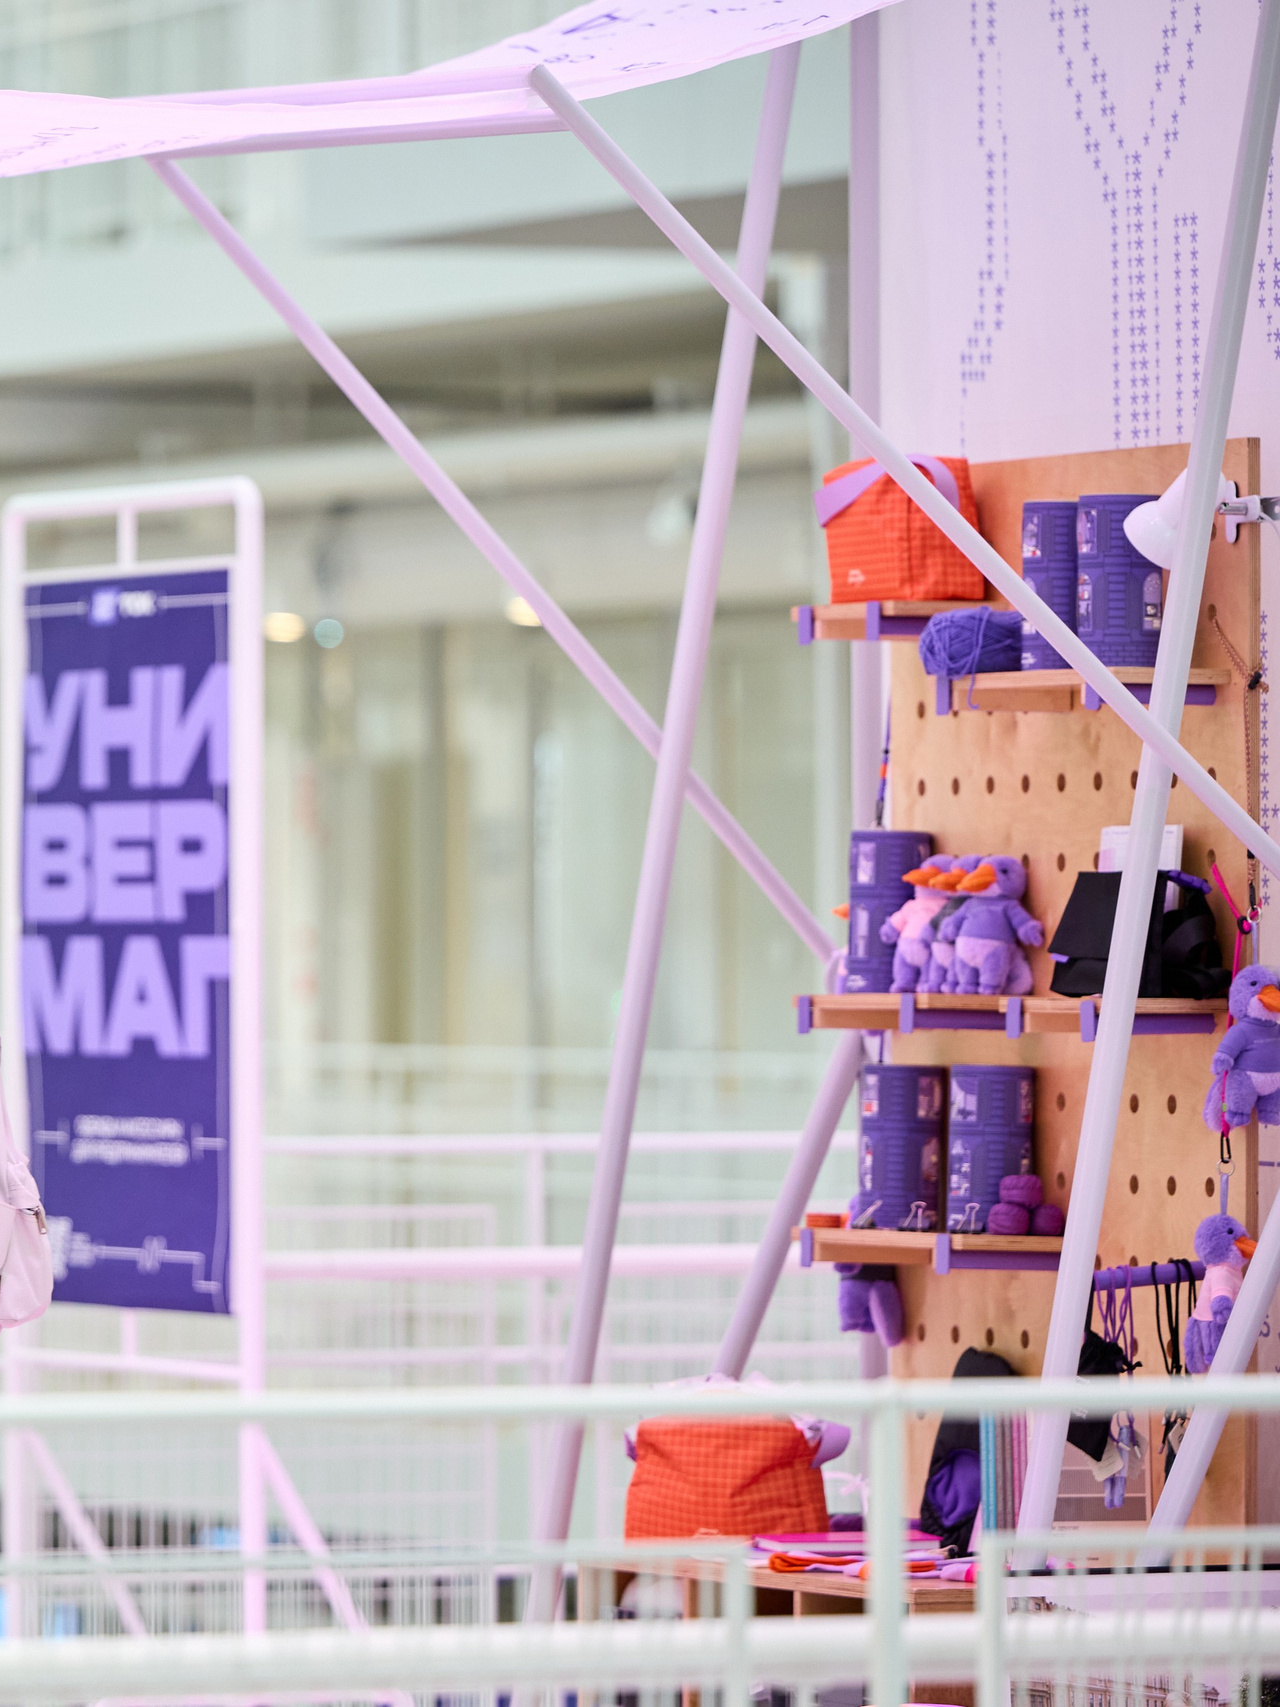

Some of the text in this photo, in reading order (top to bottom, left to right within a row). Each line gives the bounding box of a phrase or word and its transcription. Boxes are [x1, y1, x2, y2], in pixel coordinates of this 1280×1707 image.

[23, 664, 230, 791] УНИ
[23, 800, 230, 923] ВЕР
[22, 935, 230, 1058] МАГ
